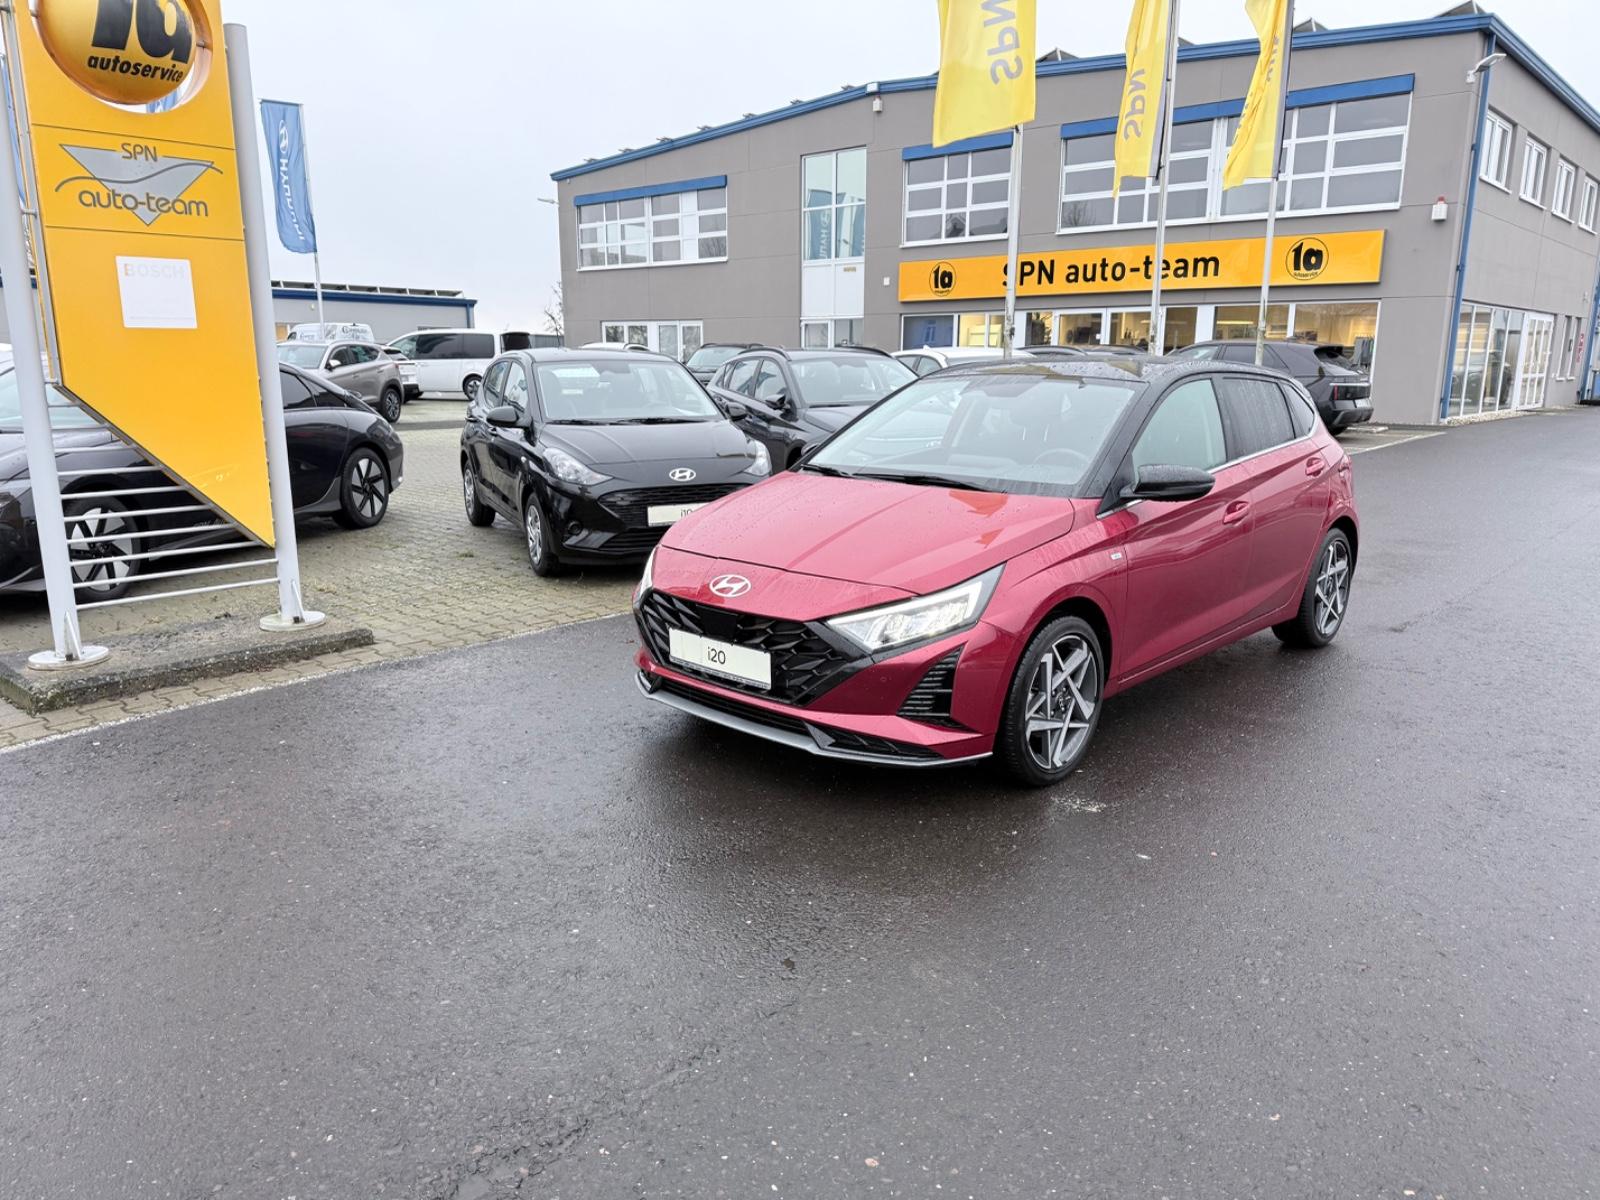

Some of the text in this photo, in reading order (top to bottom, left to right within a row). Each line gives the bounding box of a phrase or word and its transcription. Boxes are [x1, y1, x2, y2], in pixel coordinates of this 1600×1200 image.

[87, 55, 184, 83] autoservice
[120, 142, 158, 162] SPN
[78, 189, 209, 217] auto-team
[1291, 241, 1324, 271] 1a
[124, 262, 186, 279] BOSCH
[933, 265, 953, 289] 1a
[1065, 255, 1220, 284] auto-team
[707, 646, 726, 665] i20
